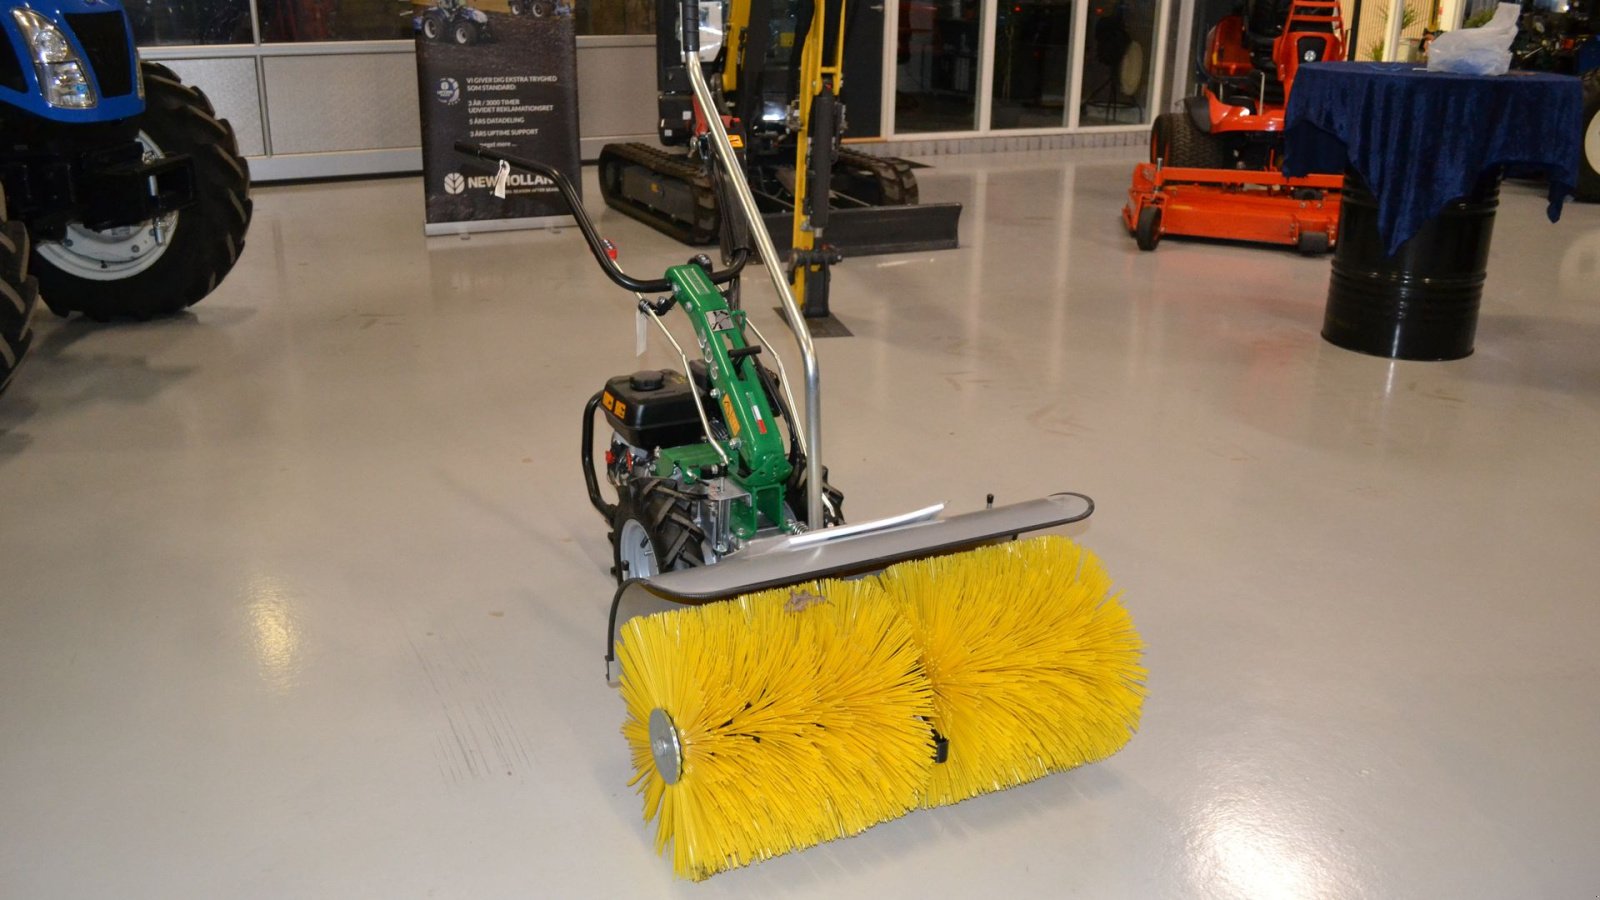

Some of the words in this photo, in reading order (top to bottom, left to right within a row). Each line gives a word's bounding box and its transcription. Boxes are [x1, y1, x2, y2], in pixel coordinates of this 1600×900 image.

[474, 76, 493, 84] GIVER
[468, 106, 495, 114] UDVIDET
[496, 104, 554, 113] REKLAMATIONSRET
[473, 117, 486, 125] ÅRS
[487, 129, 510, 137] UPTIME
[511, 128, 539, 136] SUPPORT
[467, 175, 498, 189] NEW
